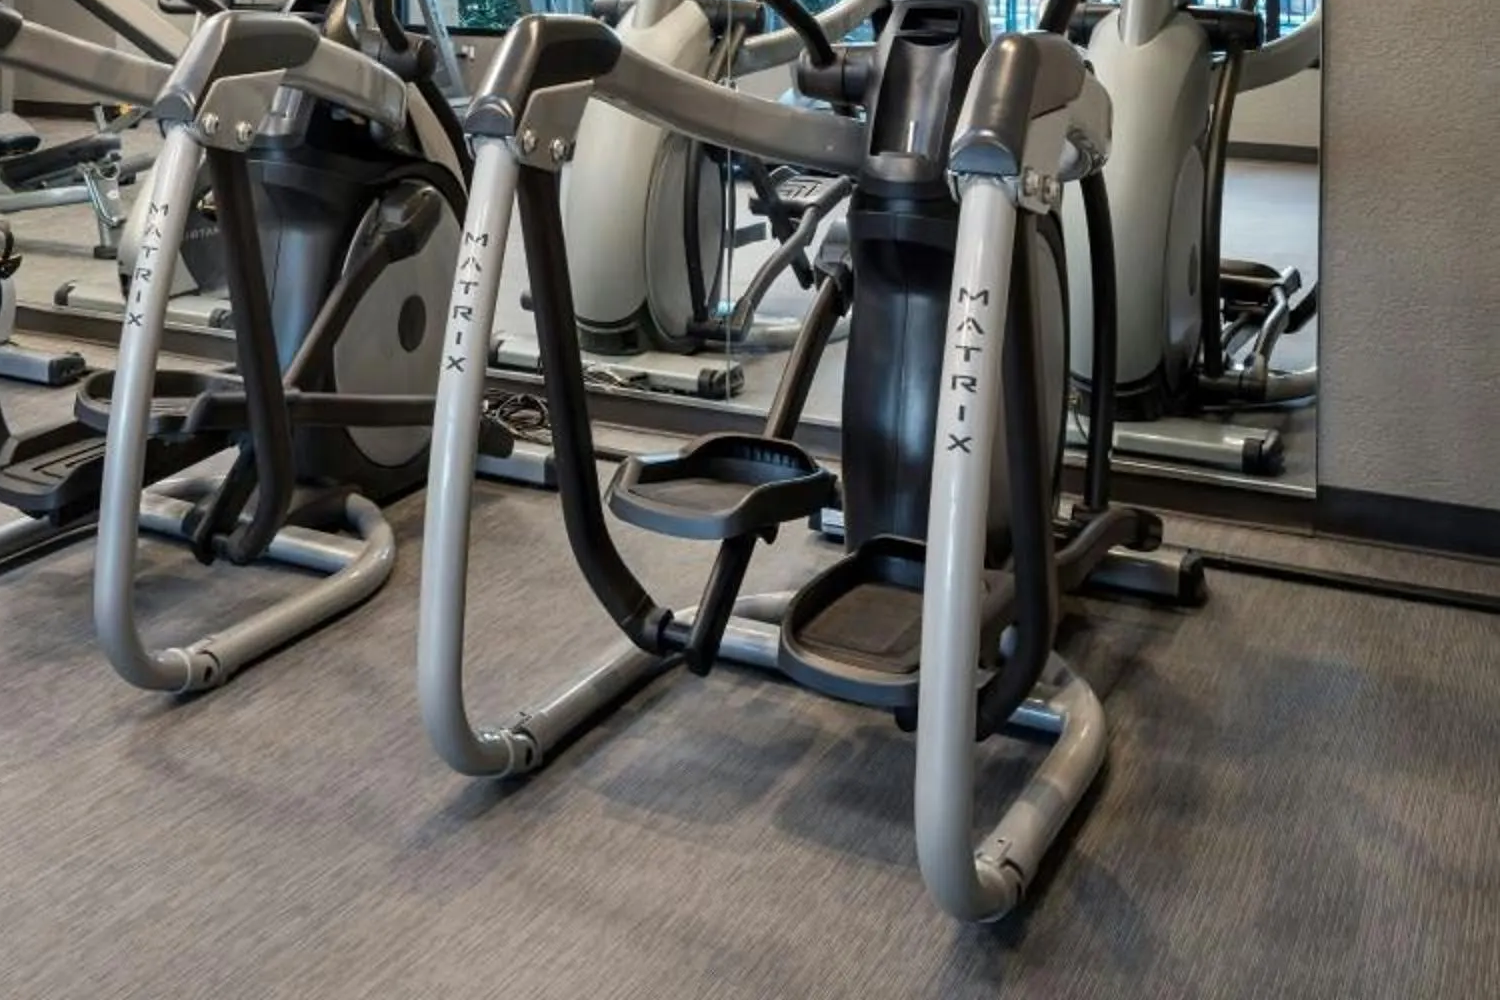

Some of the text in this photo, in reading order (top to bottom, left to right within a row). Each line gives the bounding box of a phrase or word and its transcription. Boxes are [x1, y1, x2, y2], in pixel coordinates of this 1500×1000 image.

[126, 200, 170, 328] MATRIX
[445, 231, 490, 373] MATRIX
[946, 286, 990, 455] MATRIX
